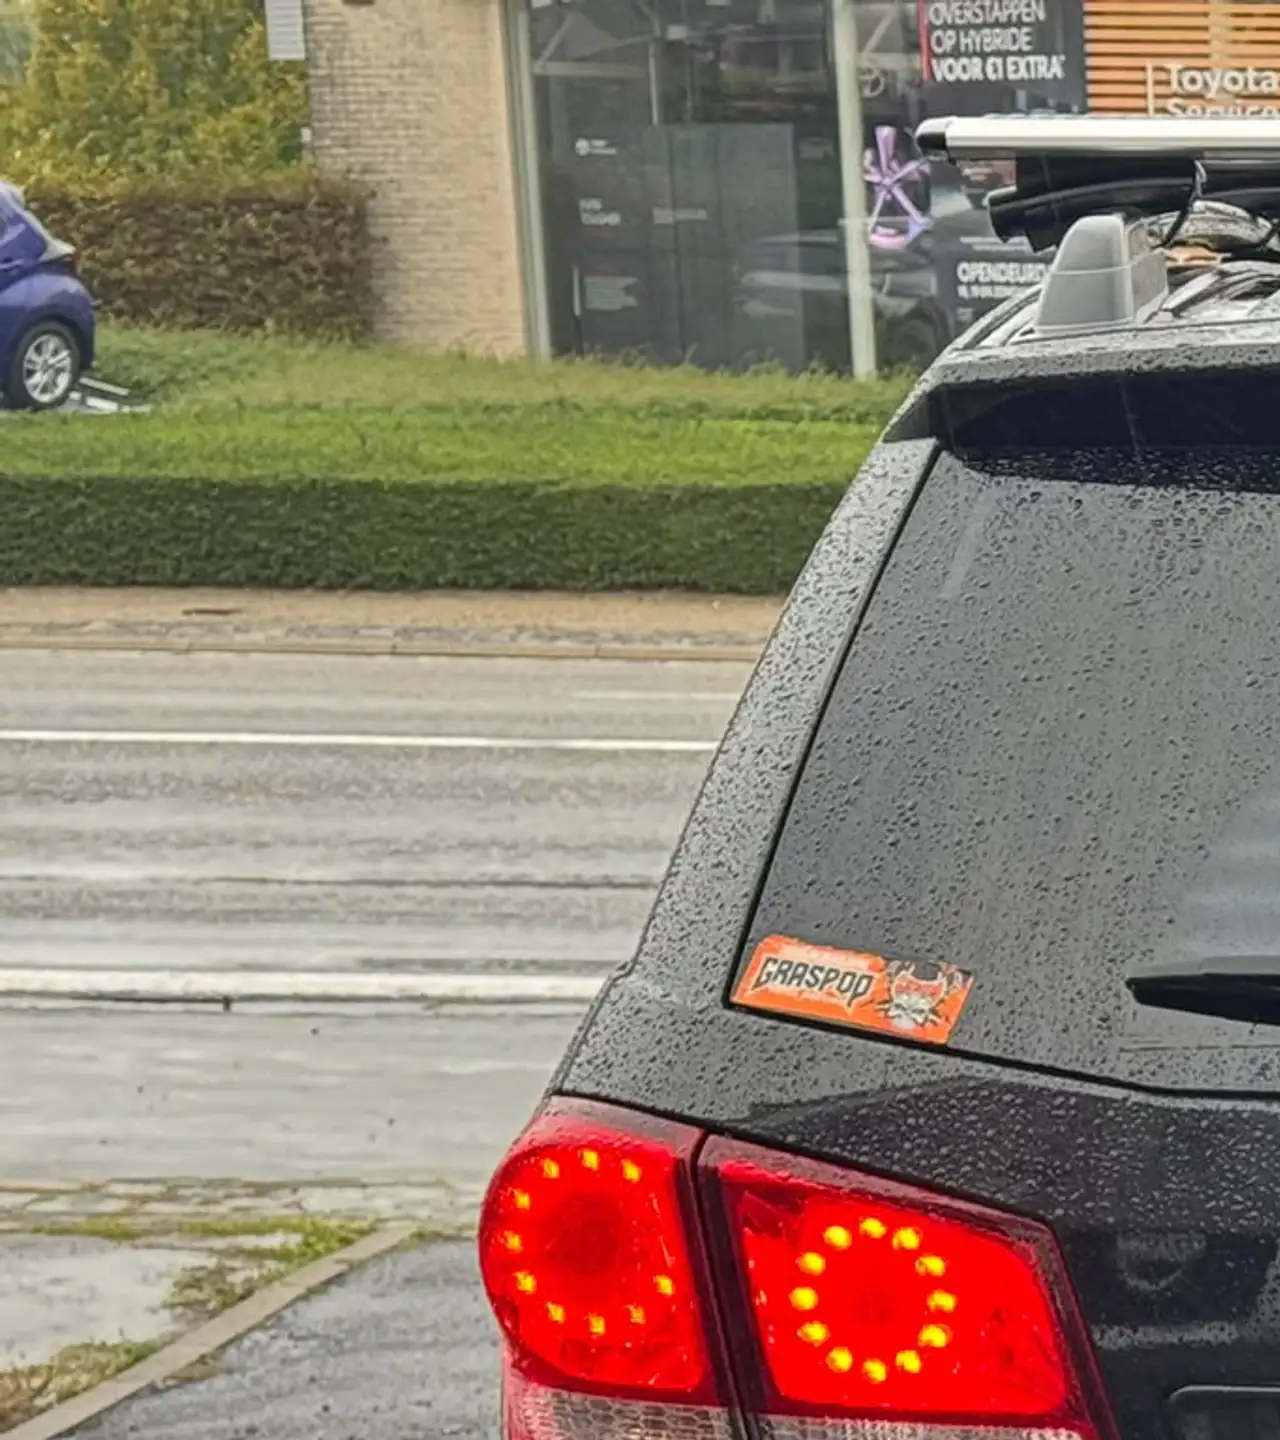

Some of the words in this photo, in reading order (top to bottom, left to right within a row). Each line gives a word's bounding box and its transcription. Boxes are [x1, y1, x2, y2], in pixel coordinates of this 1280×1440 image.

[930, 28, 956, 53] OP
[960, 27, 1034, 52] HYBRIDE
[930, 57, 983, 82] VOOR
[1164, 63, 1279, 98] Toyota
